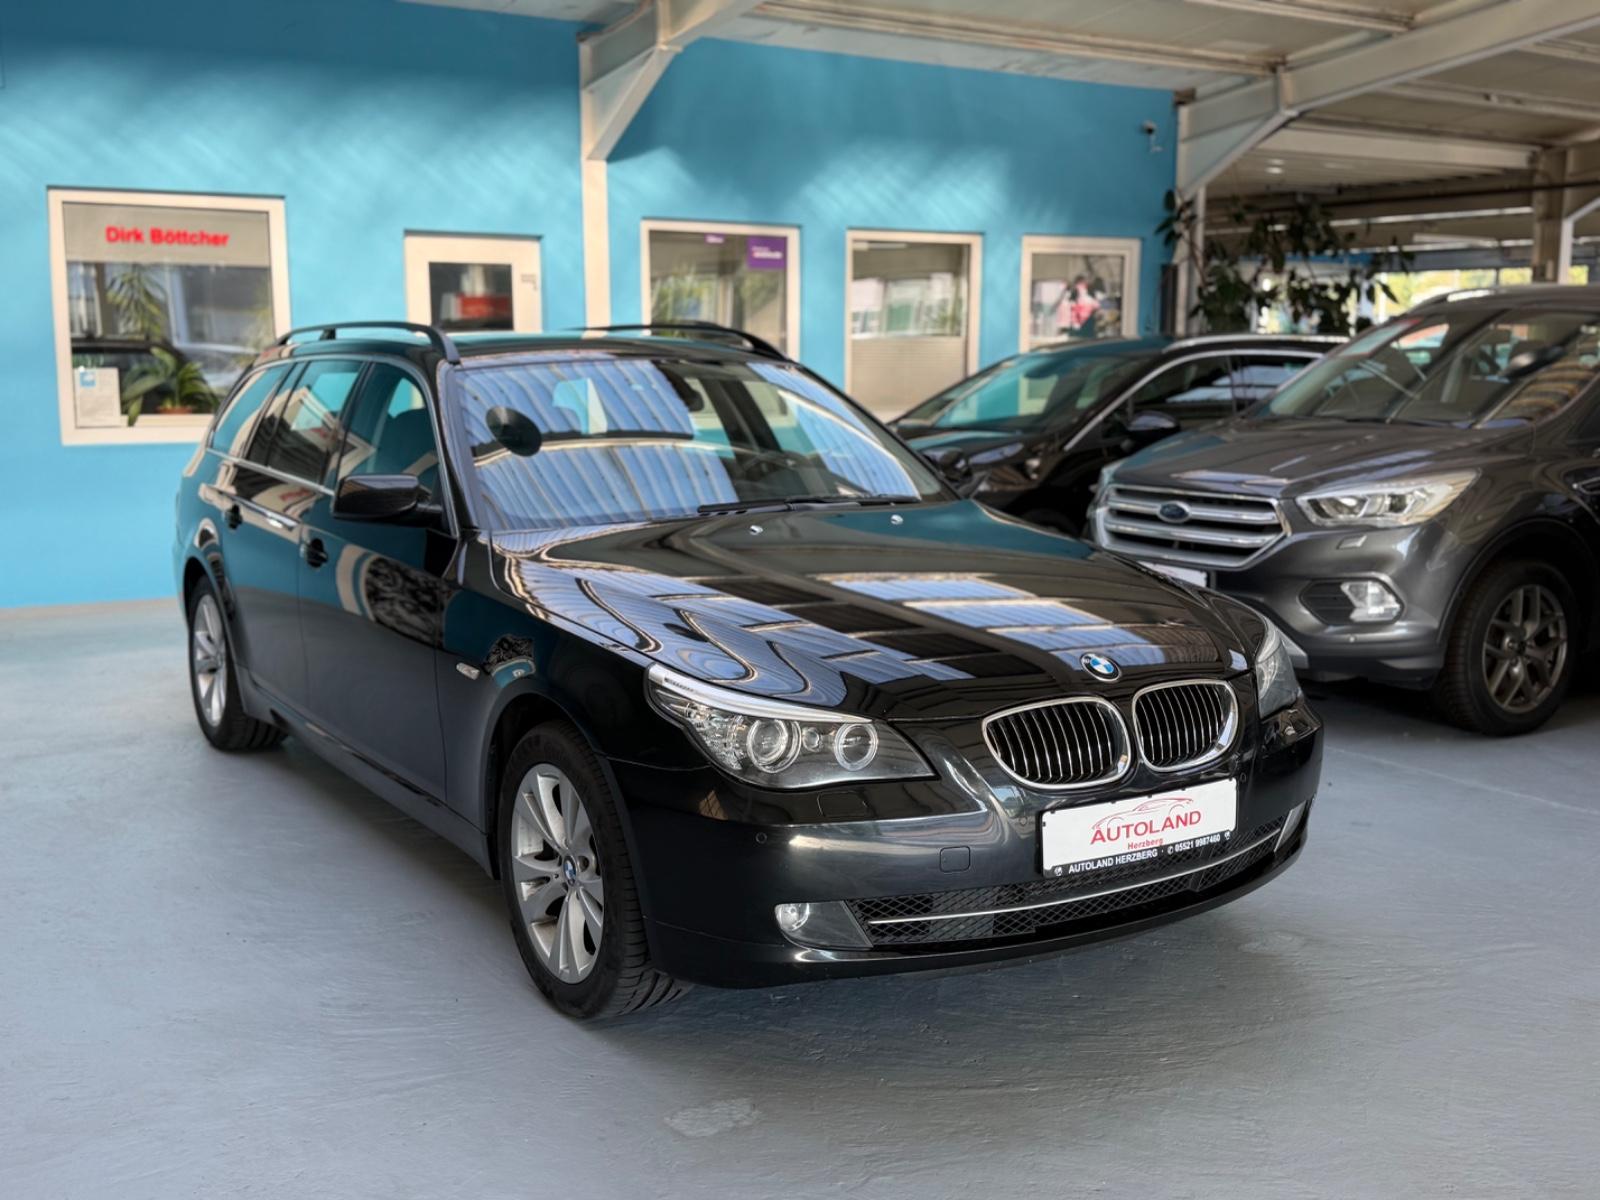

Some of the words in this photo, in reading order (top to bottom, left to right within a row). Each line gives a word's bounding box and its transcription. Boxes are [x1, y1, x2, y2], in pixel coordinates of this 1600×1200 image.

[105, 225, 144, 244] Dirk
[149, 226, 229, 247] Böttcher
[1090, 810, 1202, 845] AUTOLAND
[1127, 837, 1164, 850] Herzberg
[1068, 857, 1114, 874] AUTOLAND
[1115, 848, 1158, 865] HERZBERG
